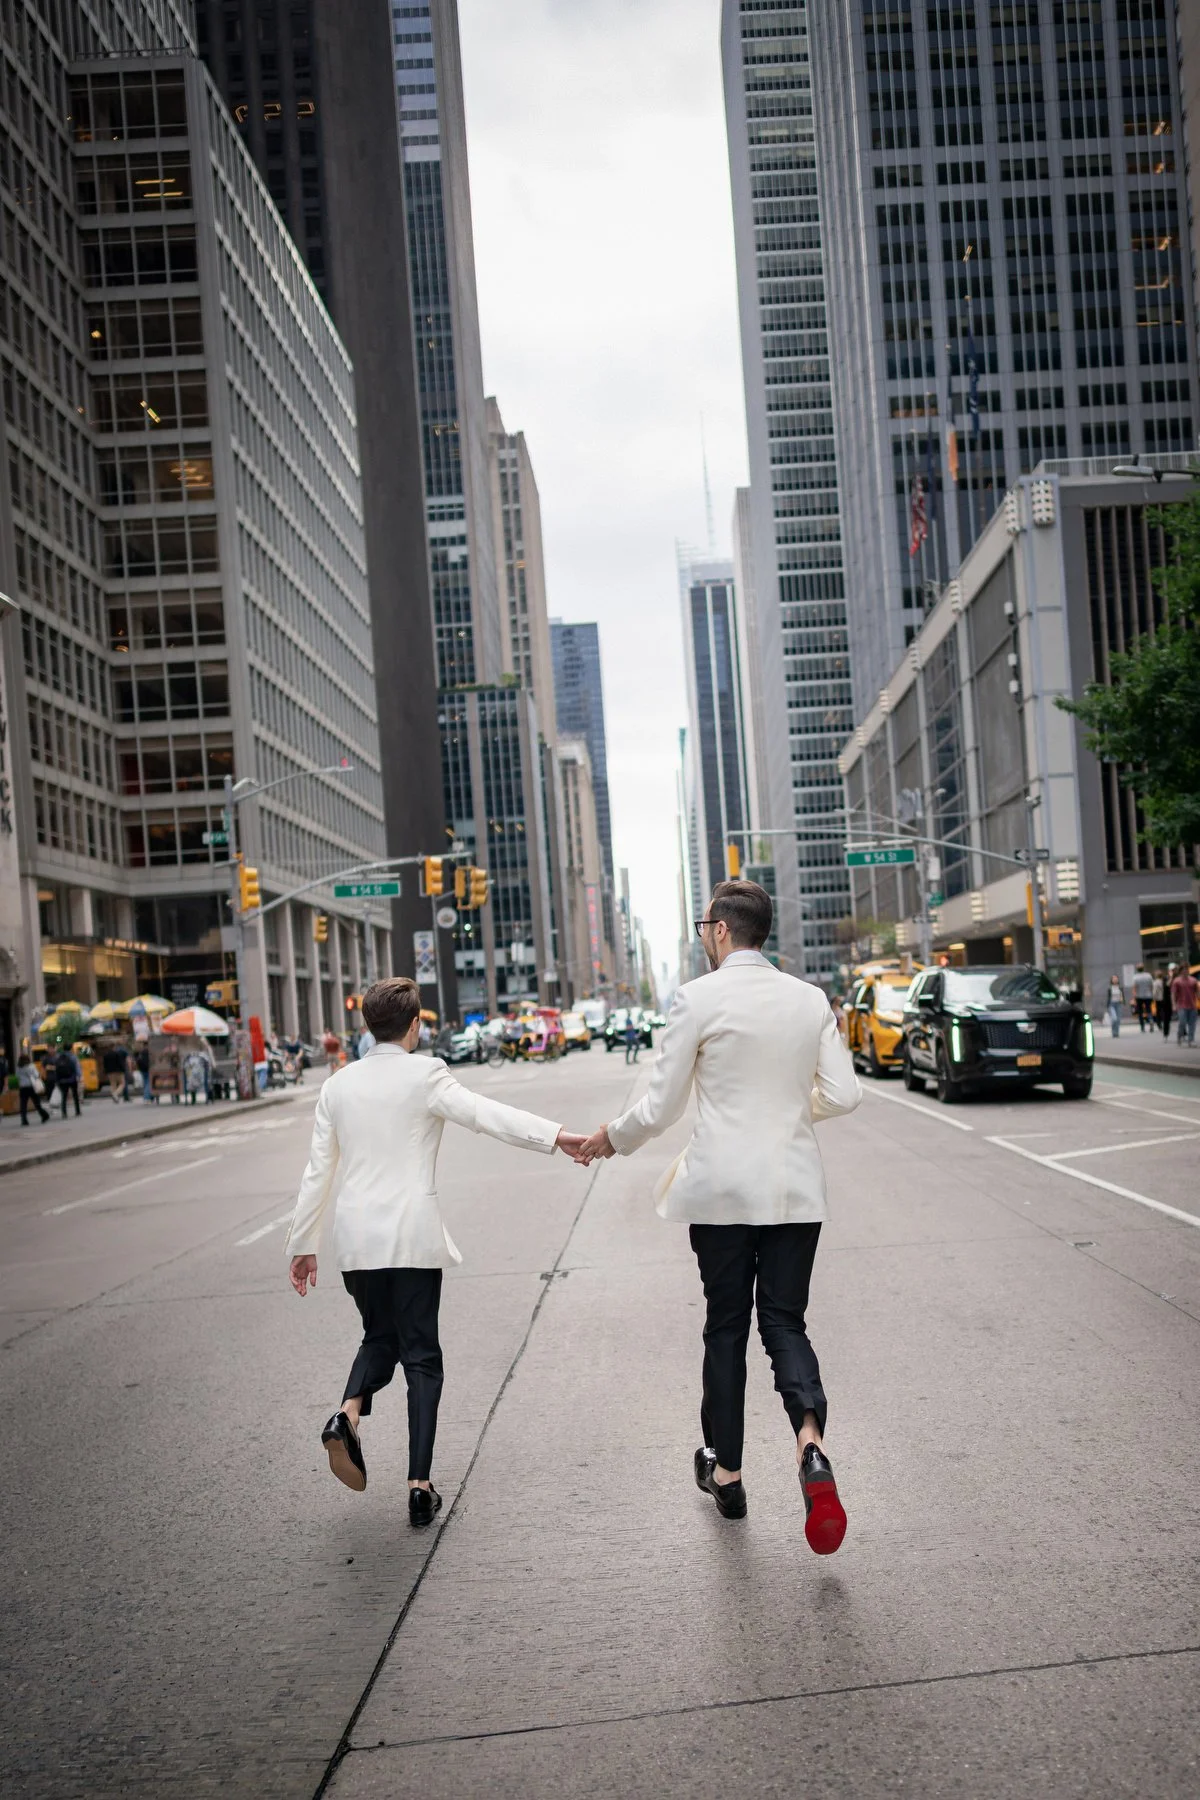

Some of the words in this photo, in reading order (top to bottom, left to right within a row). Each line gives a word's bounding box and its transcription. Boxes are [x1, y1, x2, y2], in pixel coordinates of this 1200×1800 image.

[864, 853, 871, 863] W
[873, 852, 885, 863] 54
[351, 886, 358, 896] W
[360, 885, 371, 896] 54
